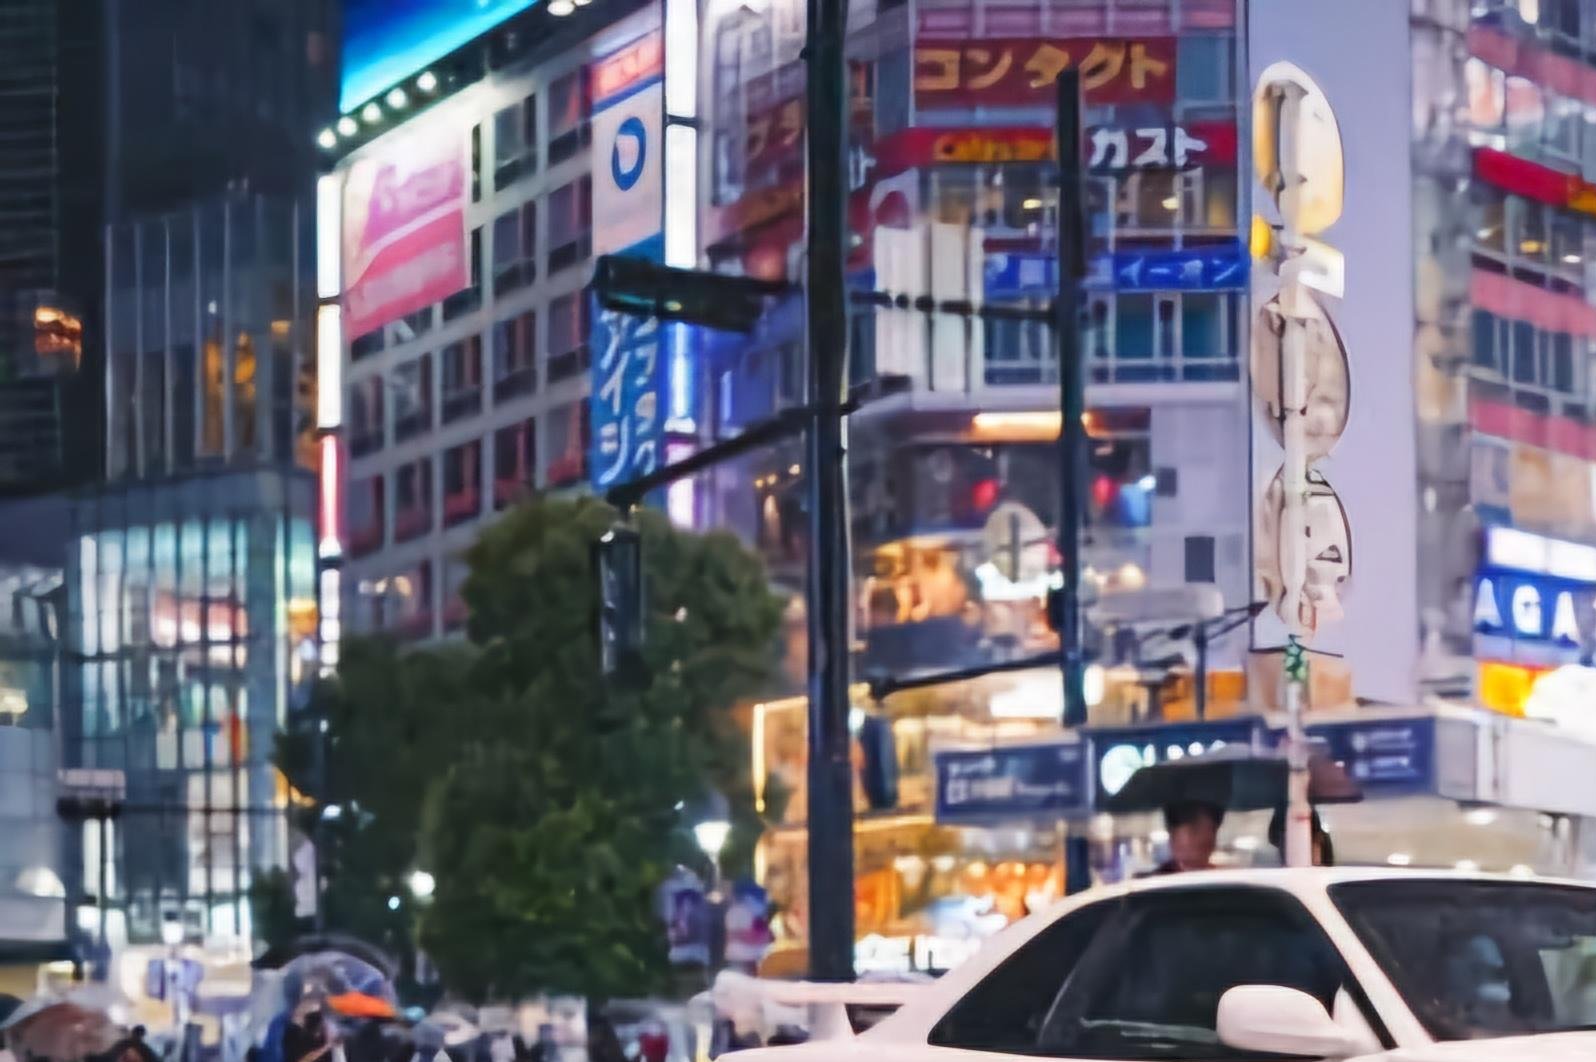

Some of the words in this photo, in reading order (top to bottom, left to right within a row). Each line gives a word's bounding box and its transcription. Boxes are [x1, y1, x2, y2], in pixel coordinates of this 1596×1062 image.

[914, 43, 1168, 91] コンタクト
